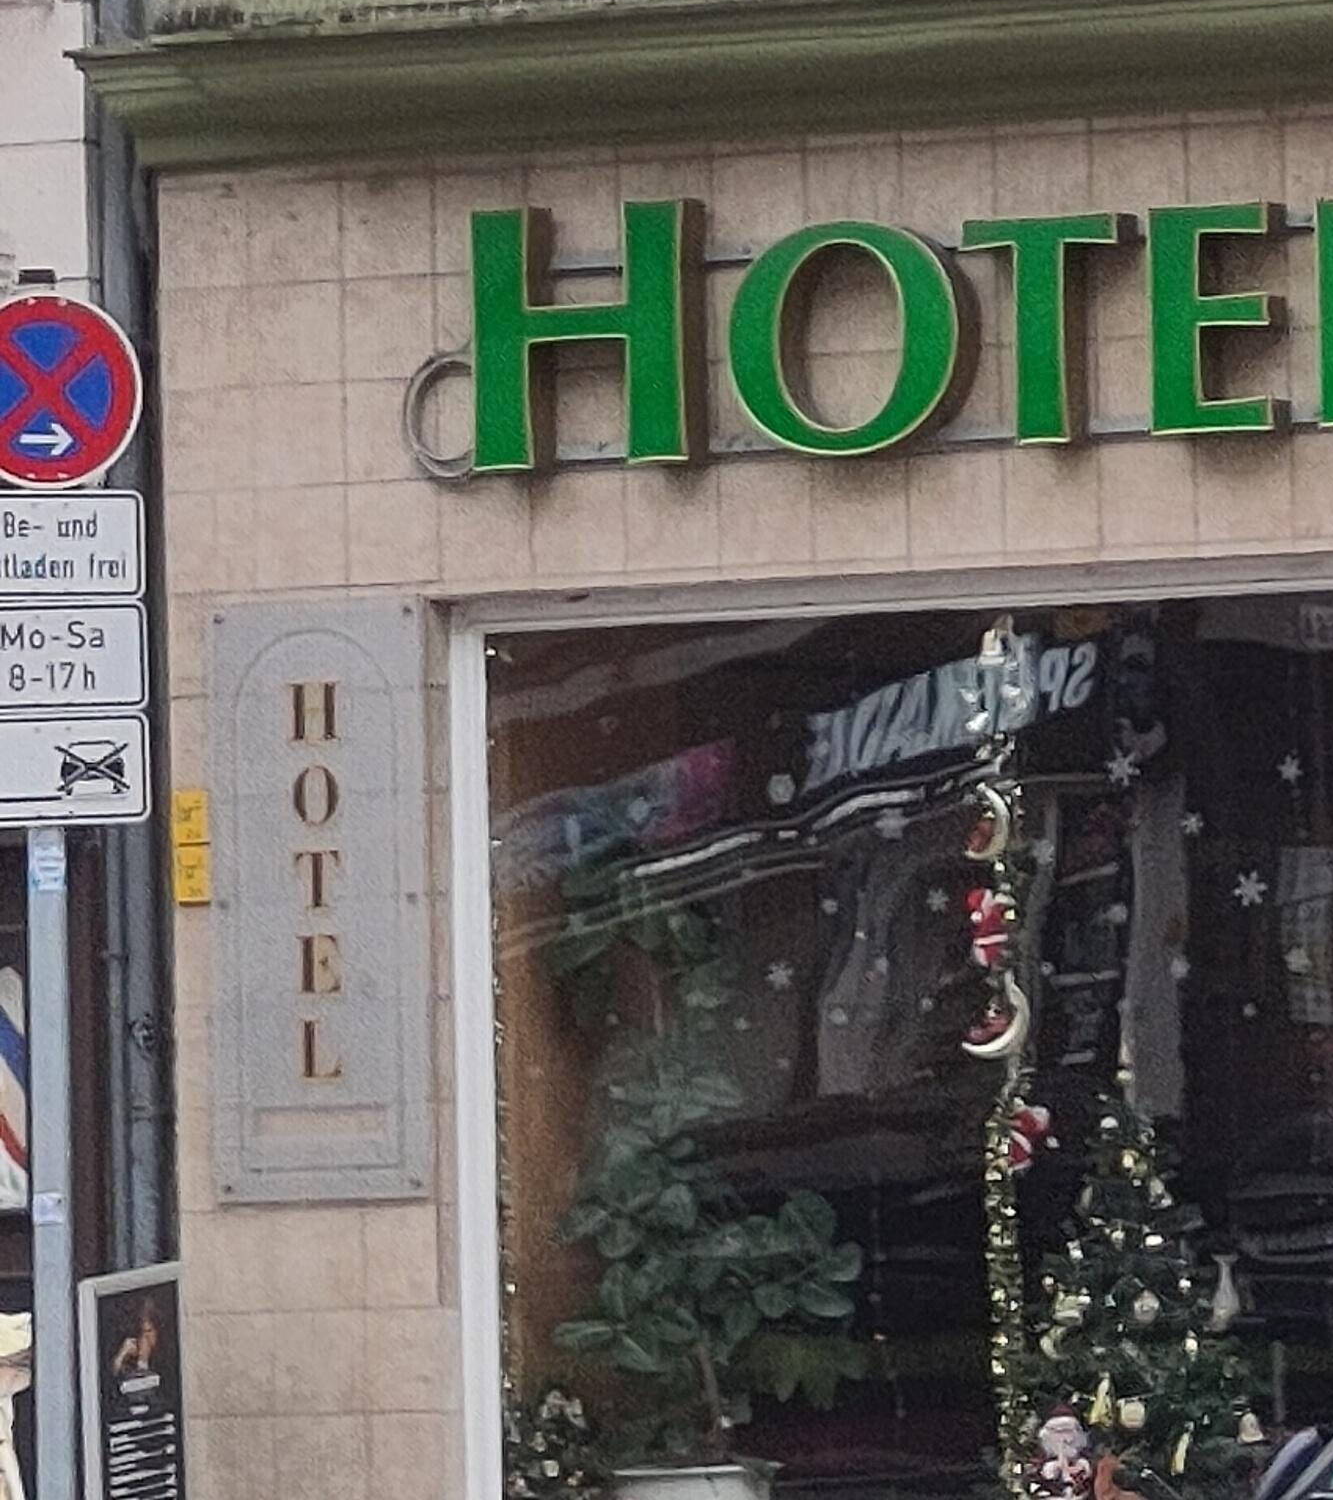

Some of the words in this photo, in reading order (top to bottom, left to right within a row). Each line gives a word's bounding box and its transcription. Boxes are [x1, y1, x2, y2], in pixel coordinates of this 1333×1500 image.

[4, 510, 44, 539] Be-
[57, 510, 98, 539] und
[0, 552, 75, 580] tladen
[89, 552, 127, 579] frei
[0, 619, 106, 650] Mo-Sa
[289, 680, 342, 1079] HOTEL
